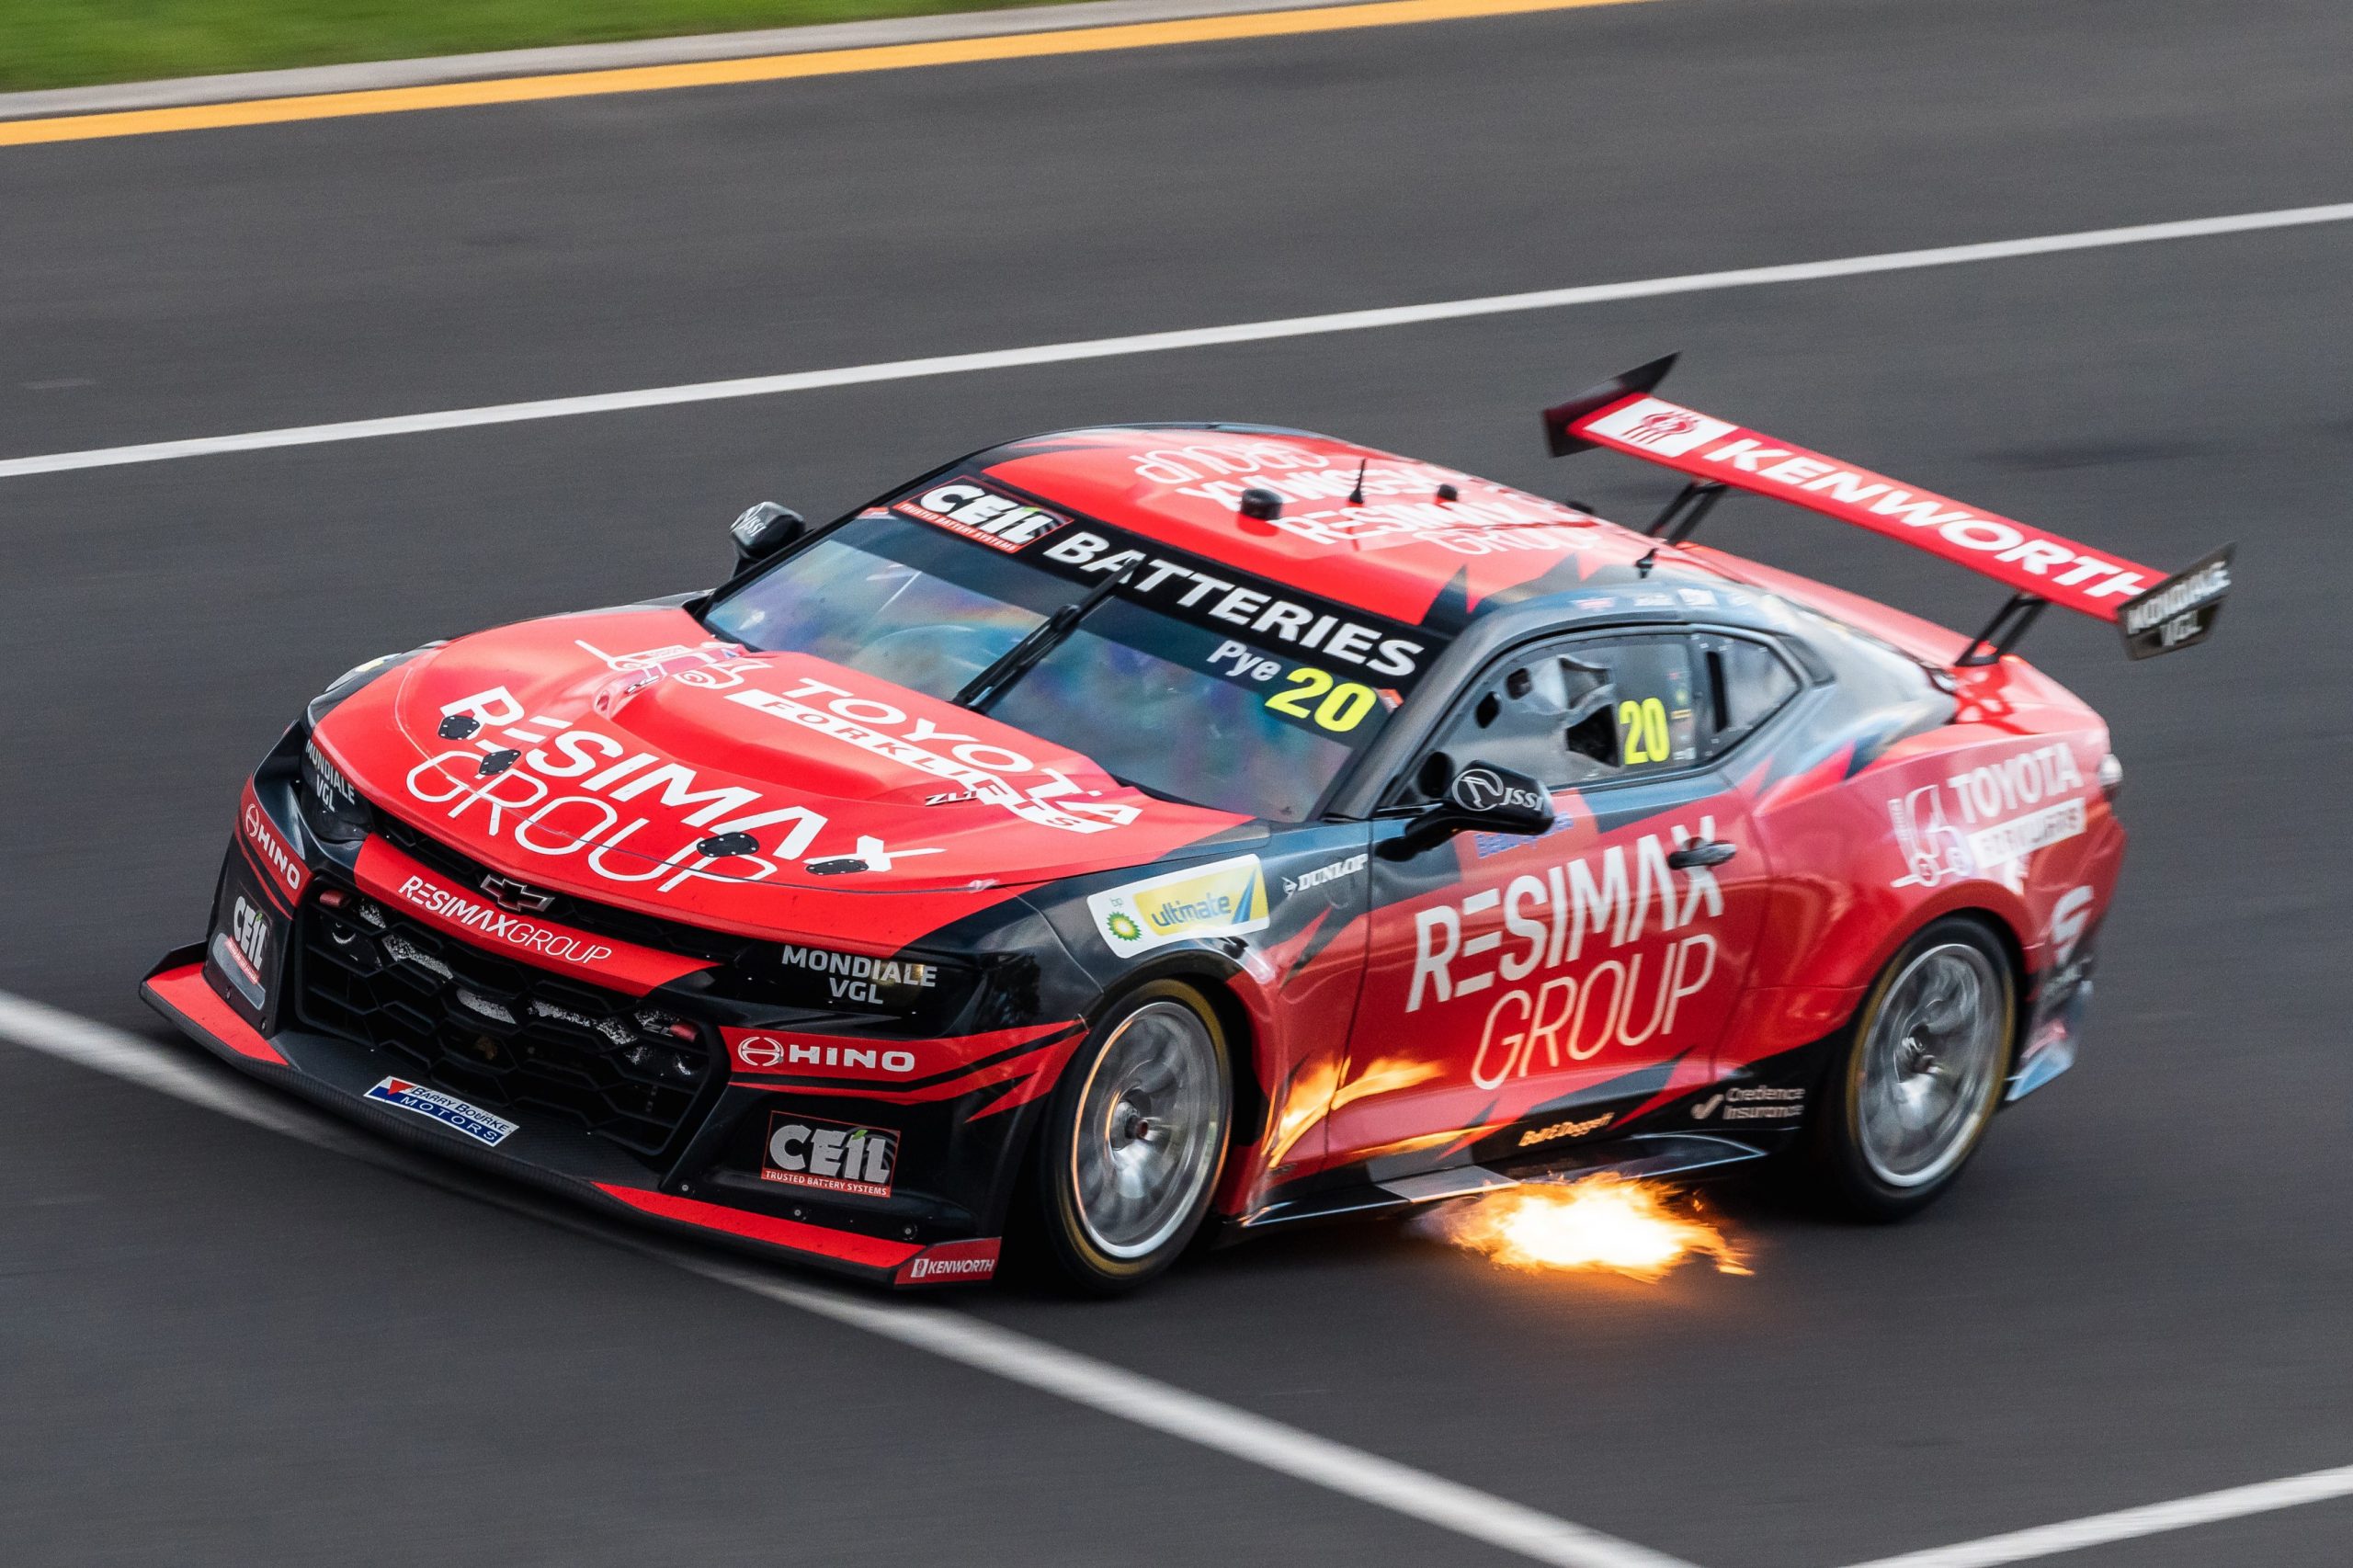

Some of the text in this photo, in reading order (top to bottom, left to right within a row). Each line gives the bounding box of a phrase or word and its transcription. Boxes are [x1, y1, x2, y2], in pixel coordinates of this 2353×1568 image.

[1702, 438, 2147, 597] KENWORTH
[1043, 532, 1425, 676] BATTERIES
[1207, 640, 1377, 733] Pye 20
[782, 677, 1142, 825] TOYOTA
[1619, 698, 1670, 765] 20
[305, 738, 356, 805] MONDIALE
[316, 774, 335, 812] VGL
[438, 686, 945, 873] RESIMAX
[1947, 742, 2085, 824] TOYOTA
[406, 750, 779, 892] GROUP
[258, 824, 300, 890] HINO
[1298, 853, 1369, 892] DUNLOP
[1151, 892, 1232, 927] ultimate
[1406, 815, 1724, 1012] RESIMAX
[782, 945, 938, 988] MONDIALE
[829, 977, 883, 1005] VGL
[1472, 934, 1716, 1090] GROUP
[789, 1044, 915, 1073] HINO
[400, 1096, 495, 1141] MOTORS
[413, 1087, 510, 1131] BARRY BOURKE
[766, 1170, 888, 1196] TRUSTED BATTERY SYSTEMS
[926, 1259, 995, 1275] KENWORTH
